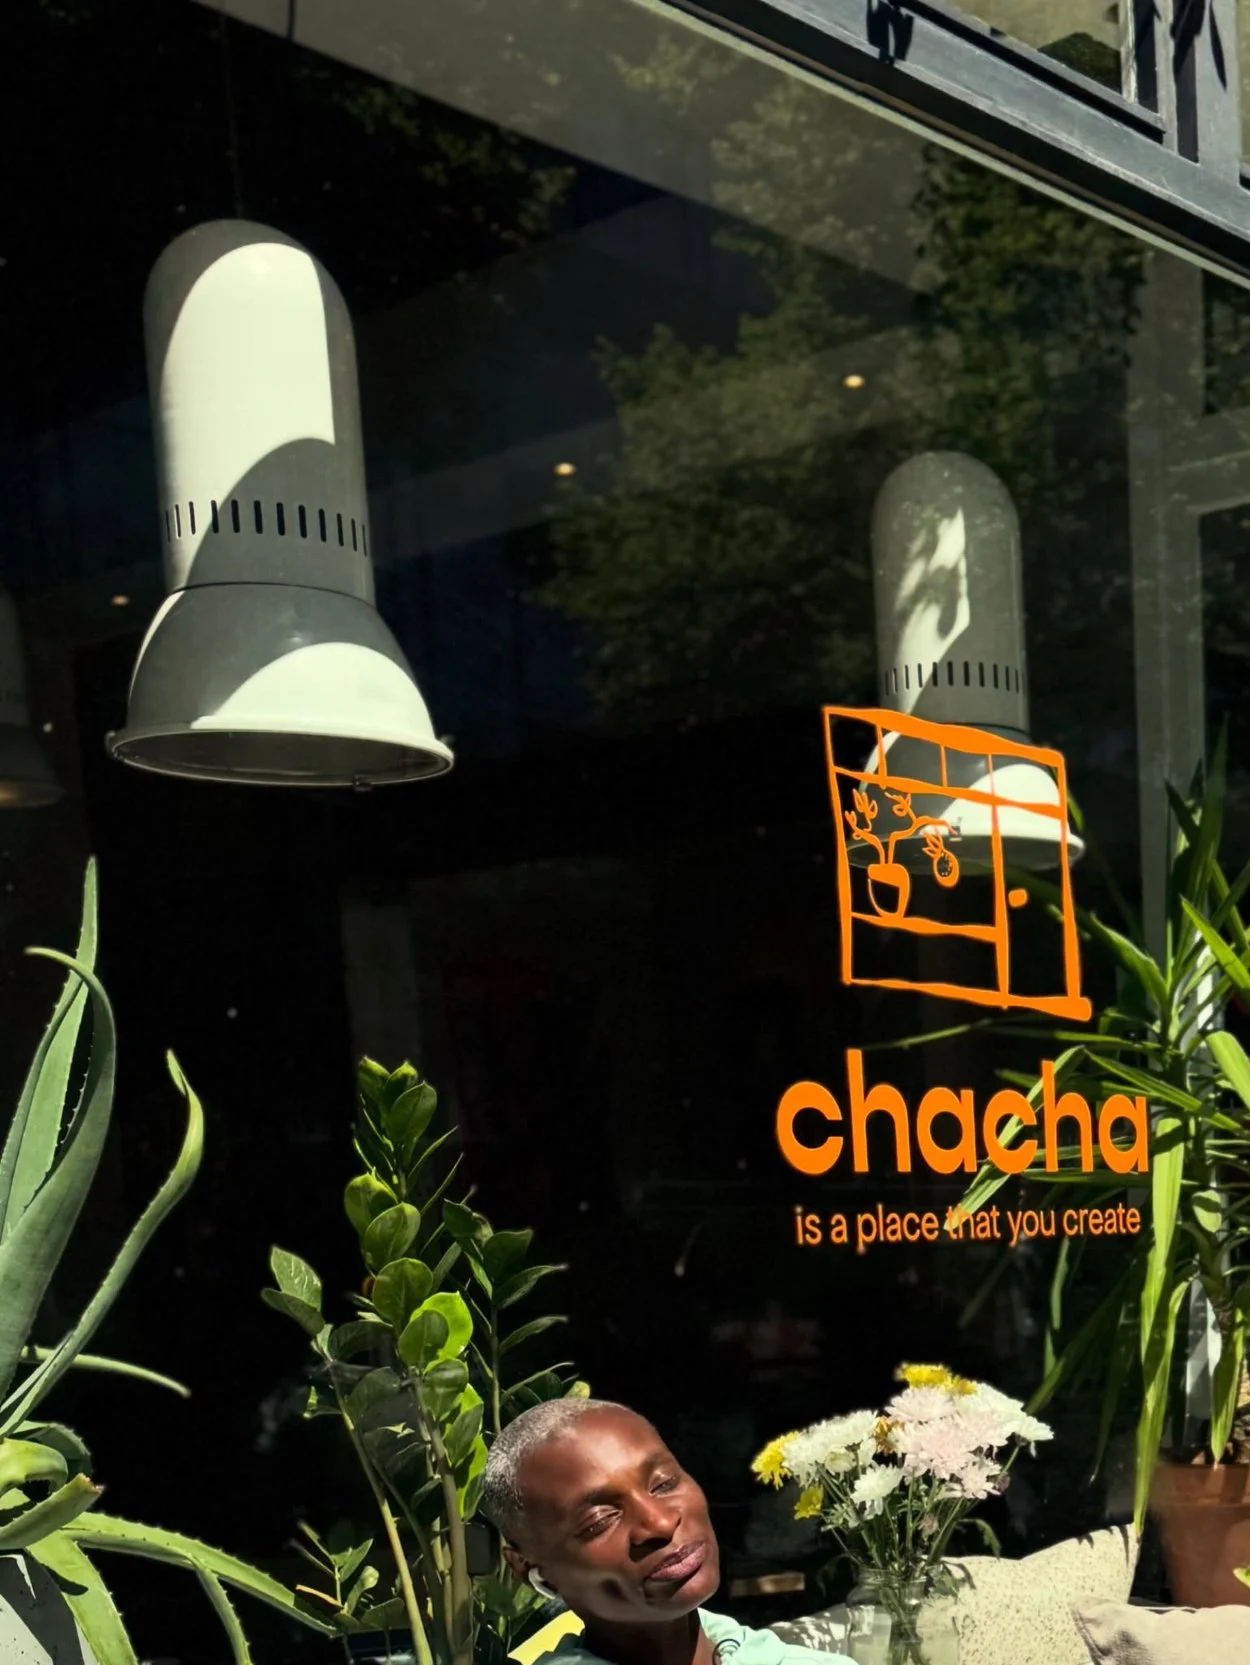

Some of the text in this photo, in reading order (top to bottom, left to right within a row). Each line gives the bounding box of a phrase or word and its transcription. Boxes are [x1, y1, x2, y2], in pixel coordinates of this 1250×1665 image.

[776, 1048, 1150, 1175] chacha
[795, 1202, 1141, 1254] is a place that you create
